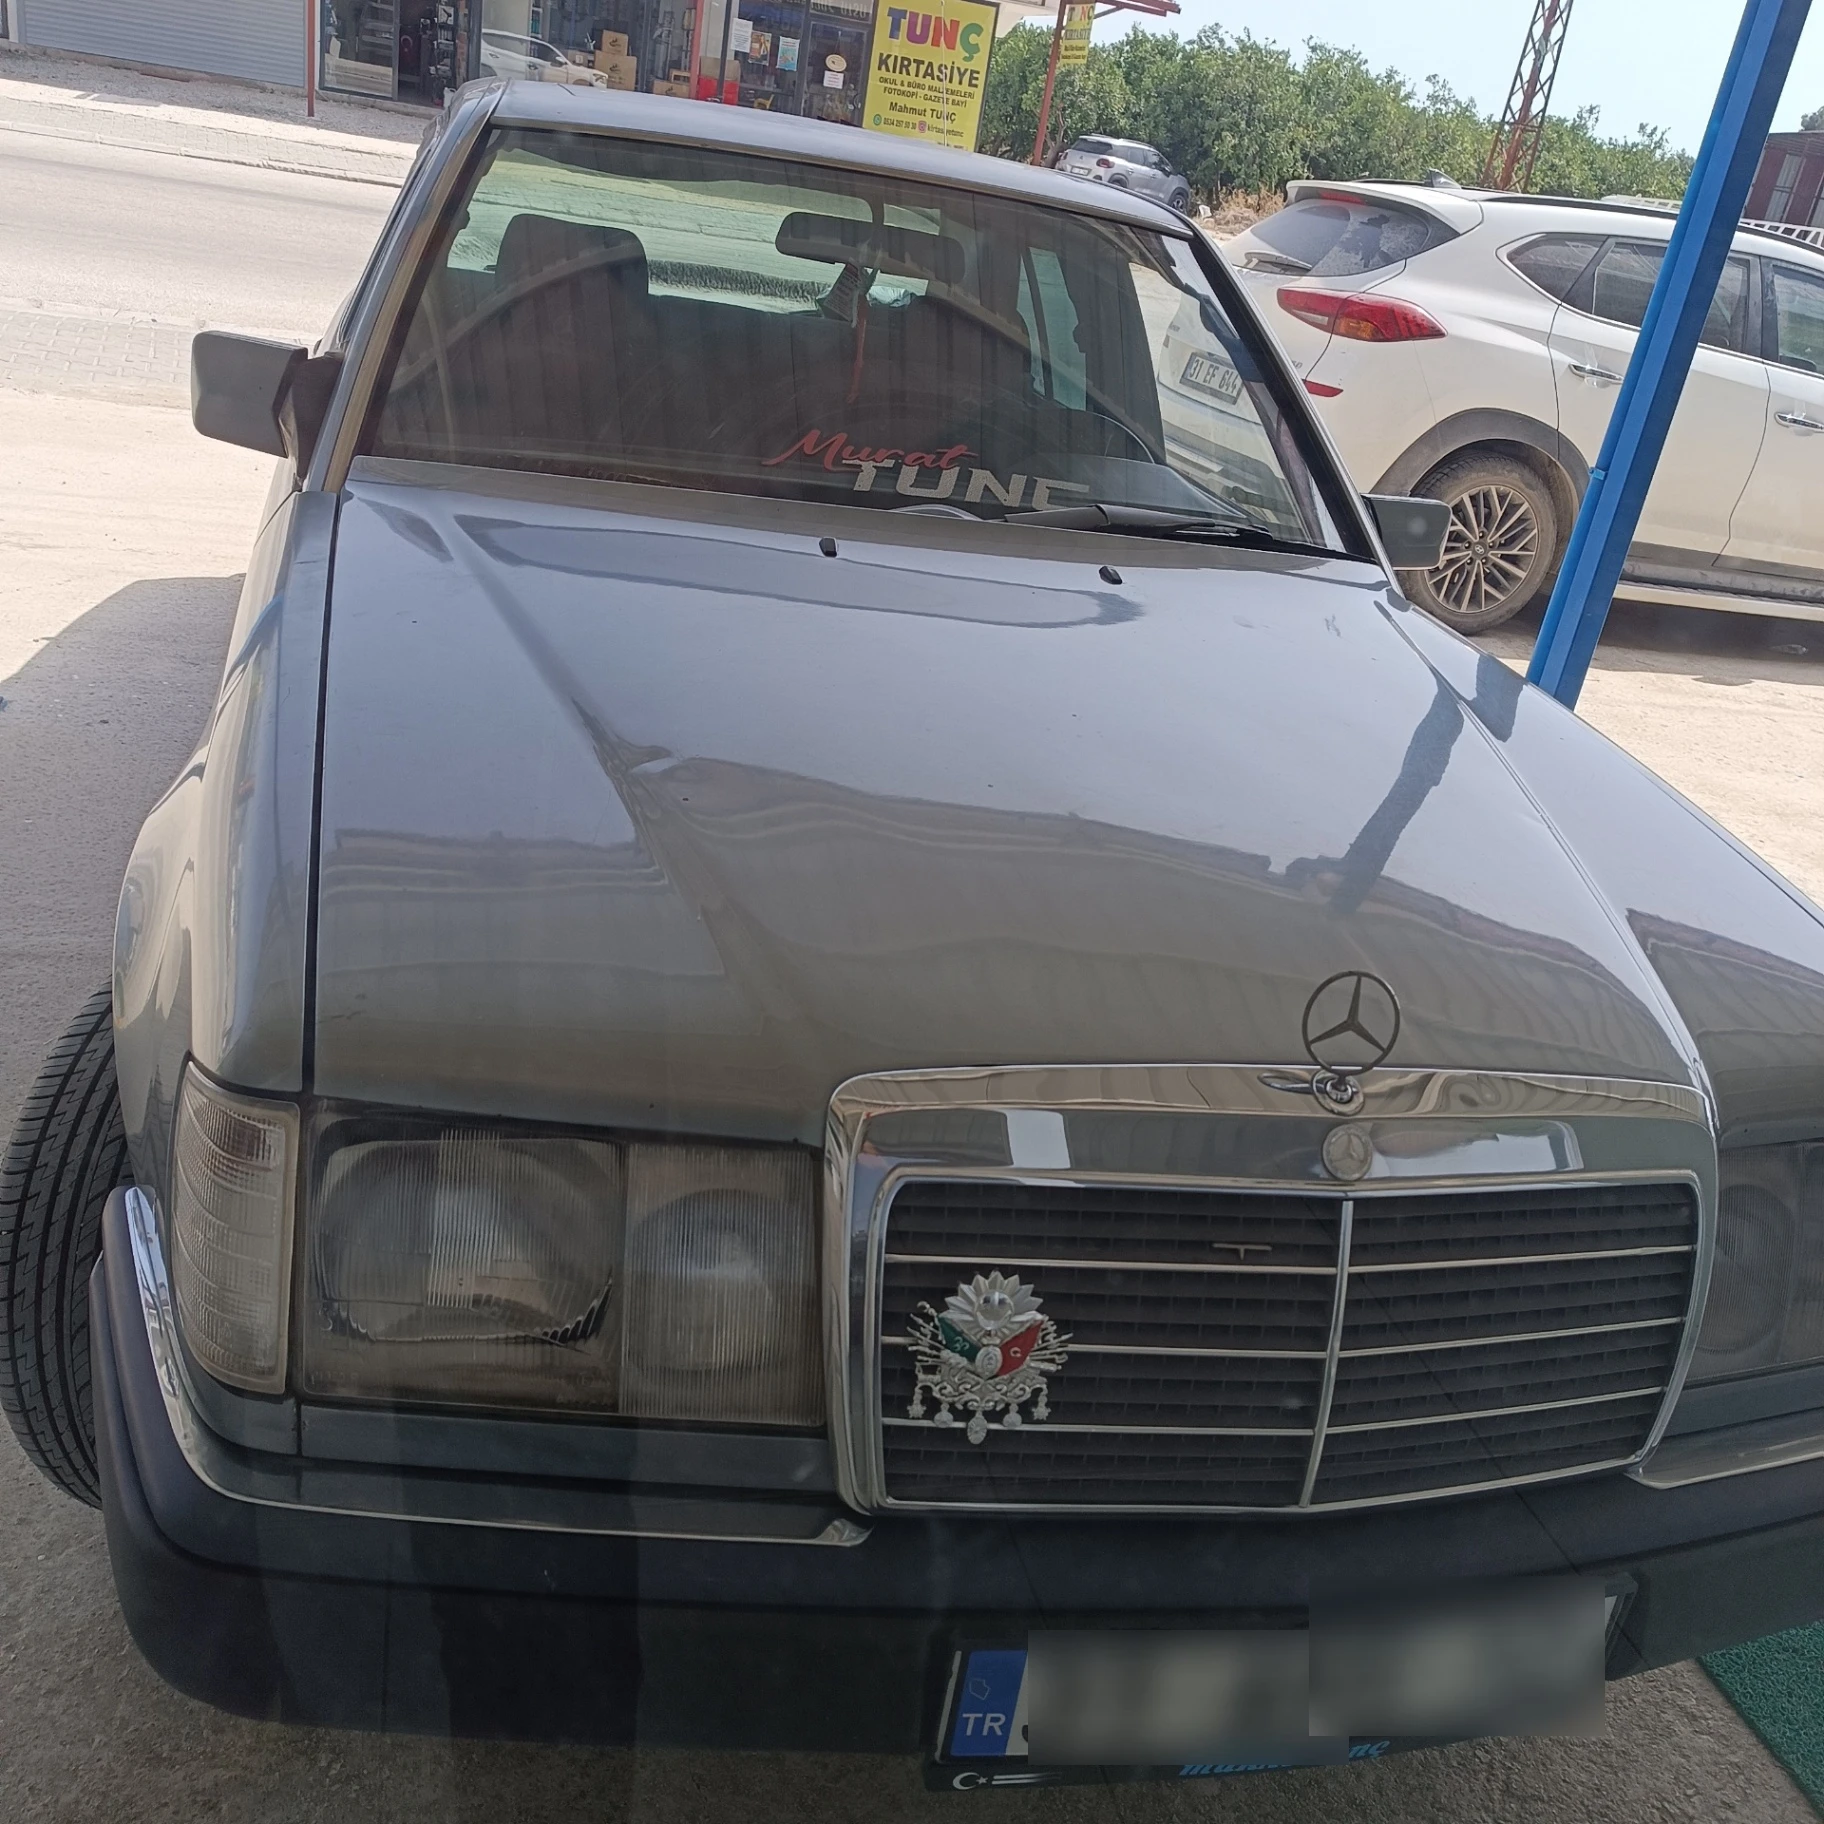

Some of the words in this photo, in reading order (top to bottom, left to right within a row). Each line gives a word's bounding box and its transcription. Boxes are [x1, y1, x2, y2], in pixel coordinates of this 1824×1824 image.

[887, 7, 984, 62] TUNÇ
[877, 52, 981, 88] KIRTASİYE
[879, 76, 898, 86] OKUL
[907, 81, 926, 90] BÜRO
[883, 86, 918, 99] FOTOKOPİ
[889, 101, 927, 117] Mahmut
[930, 108, 956, 124] TUNÇ
[1190, 359, 1204, 380] 31
[1203, 363, 1220, 384] EF
[761, 429, 979, 472] Murat
[962, 1713, 1006, 1736] TR
